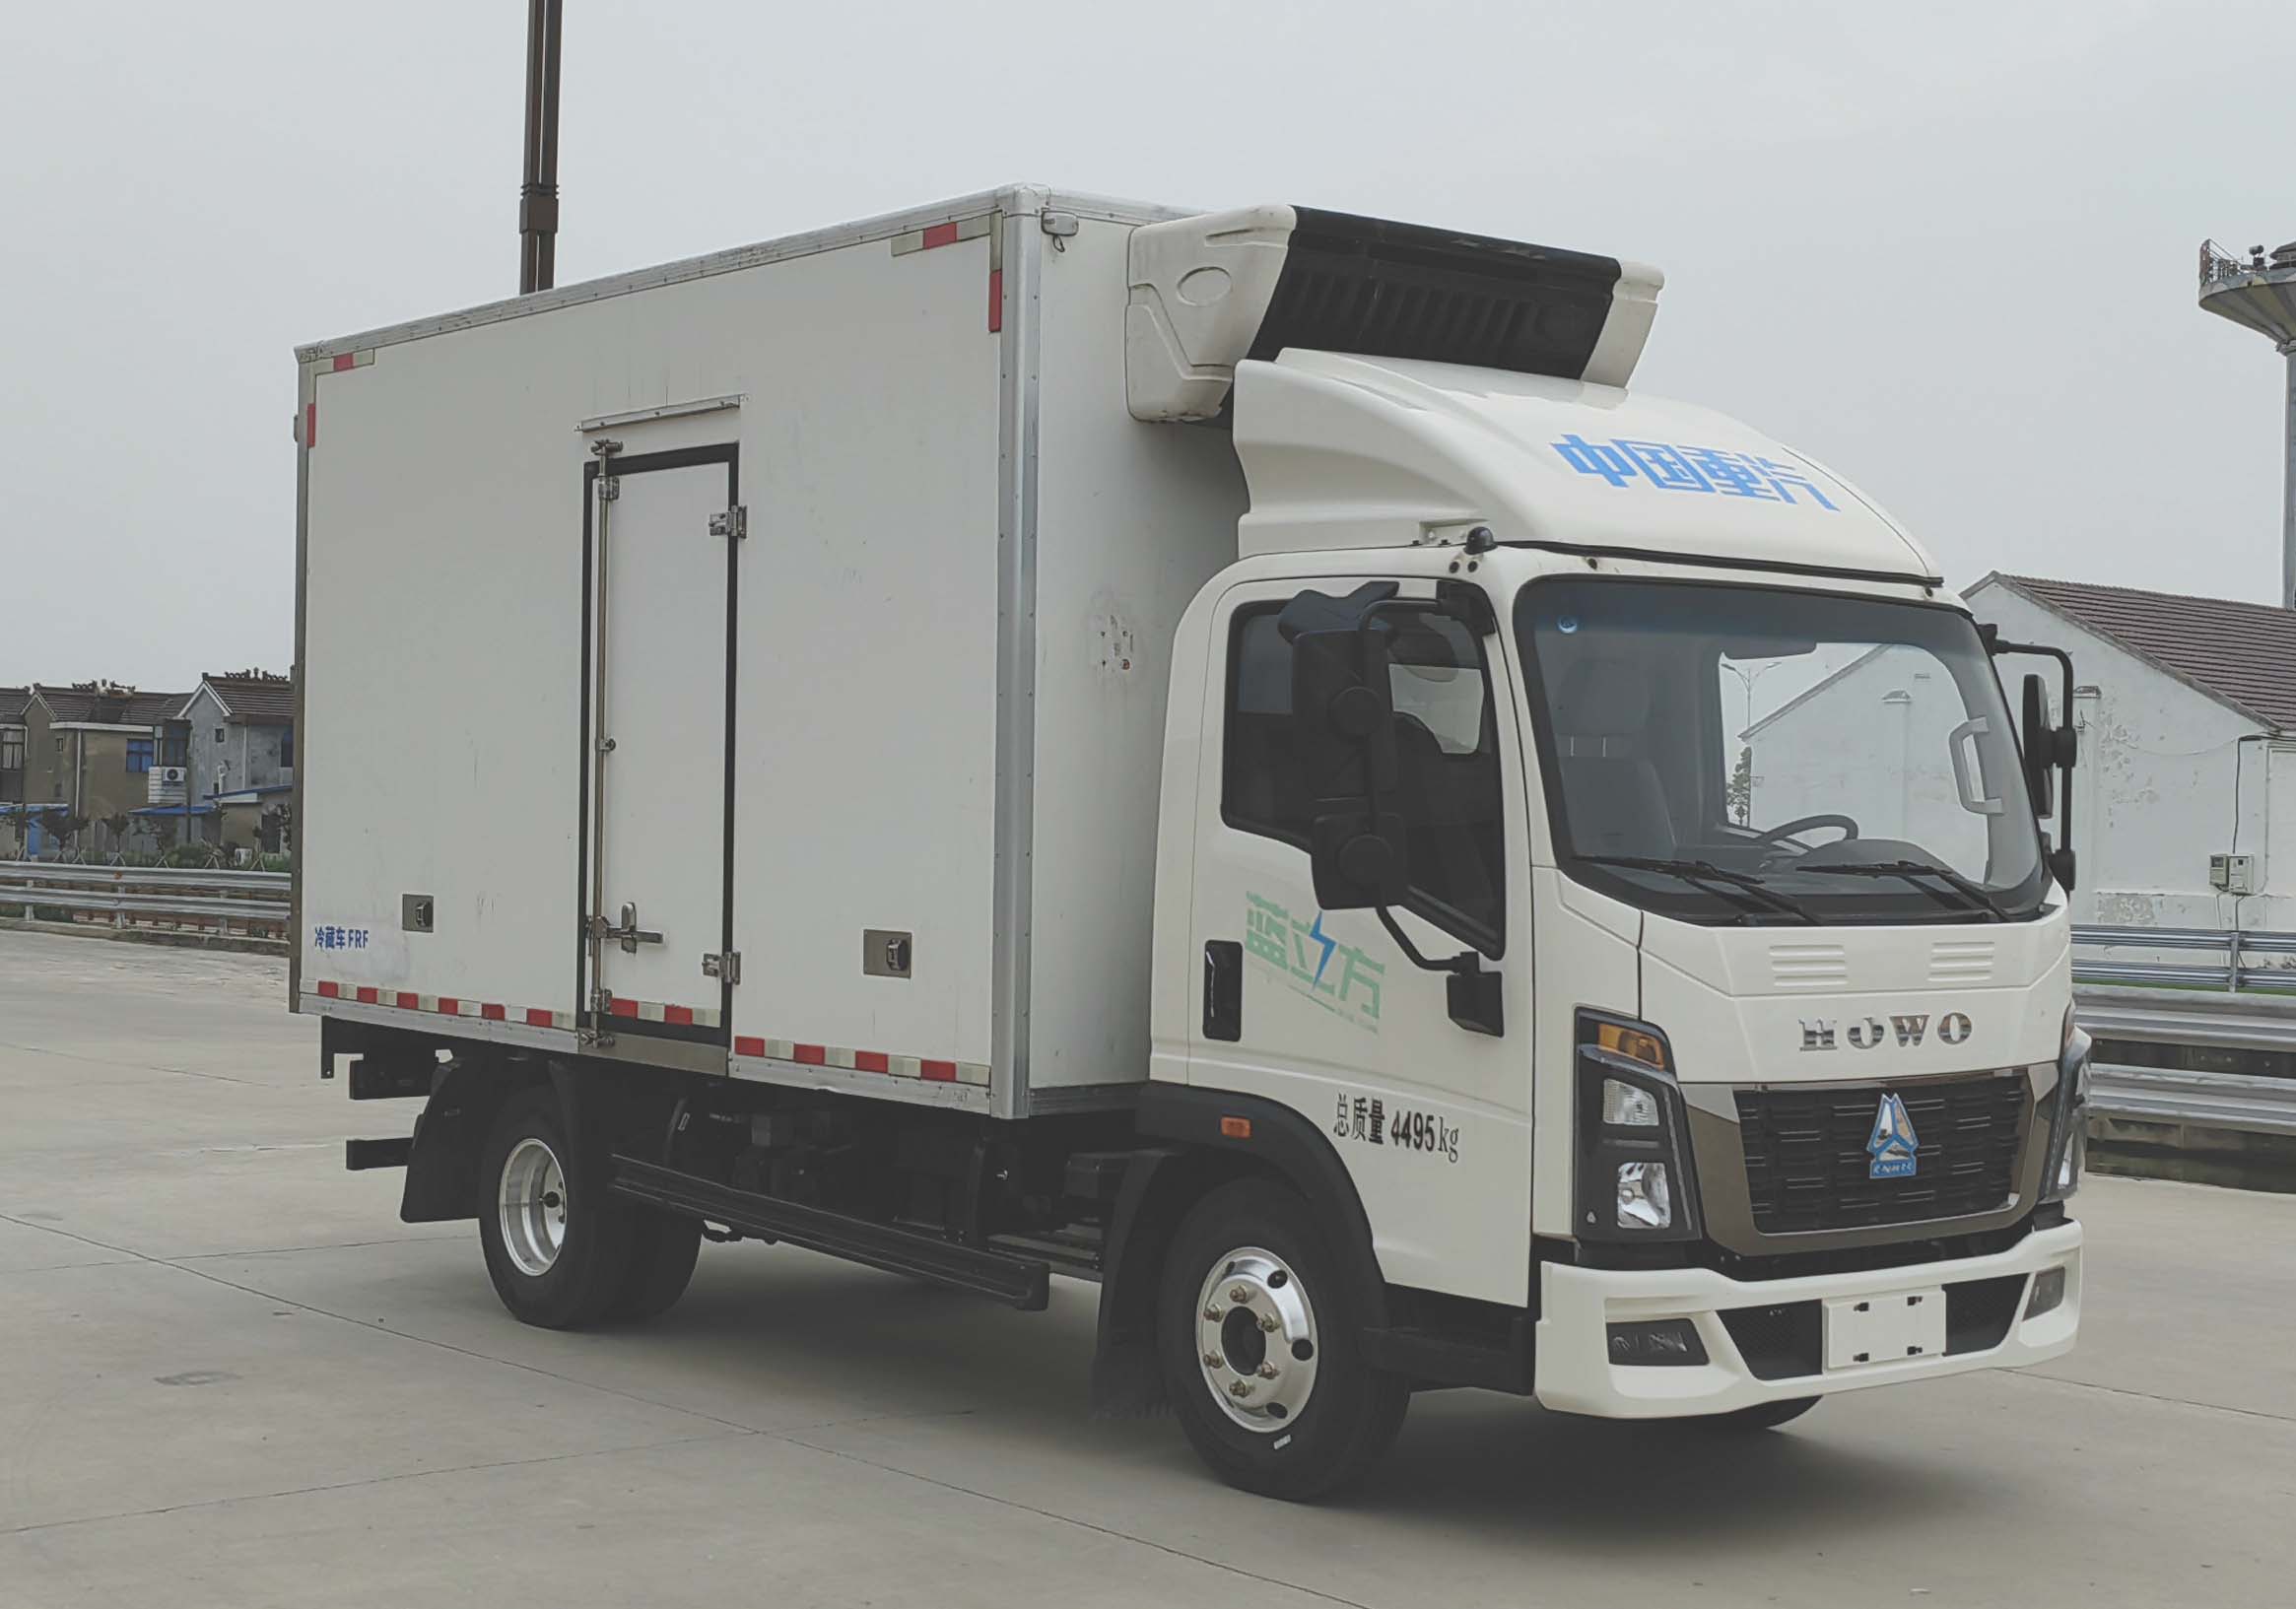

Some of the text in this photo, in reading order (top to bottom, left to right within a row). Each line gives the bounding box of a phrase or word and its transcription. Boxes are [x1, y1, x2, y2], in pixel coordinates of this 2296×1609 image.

[315, 926, 345, 950] 冷藏车
[1798, 1012, 1972, 1052] HOWO
[1333, 1093, 1385, 1145] 总质量
